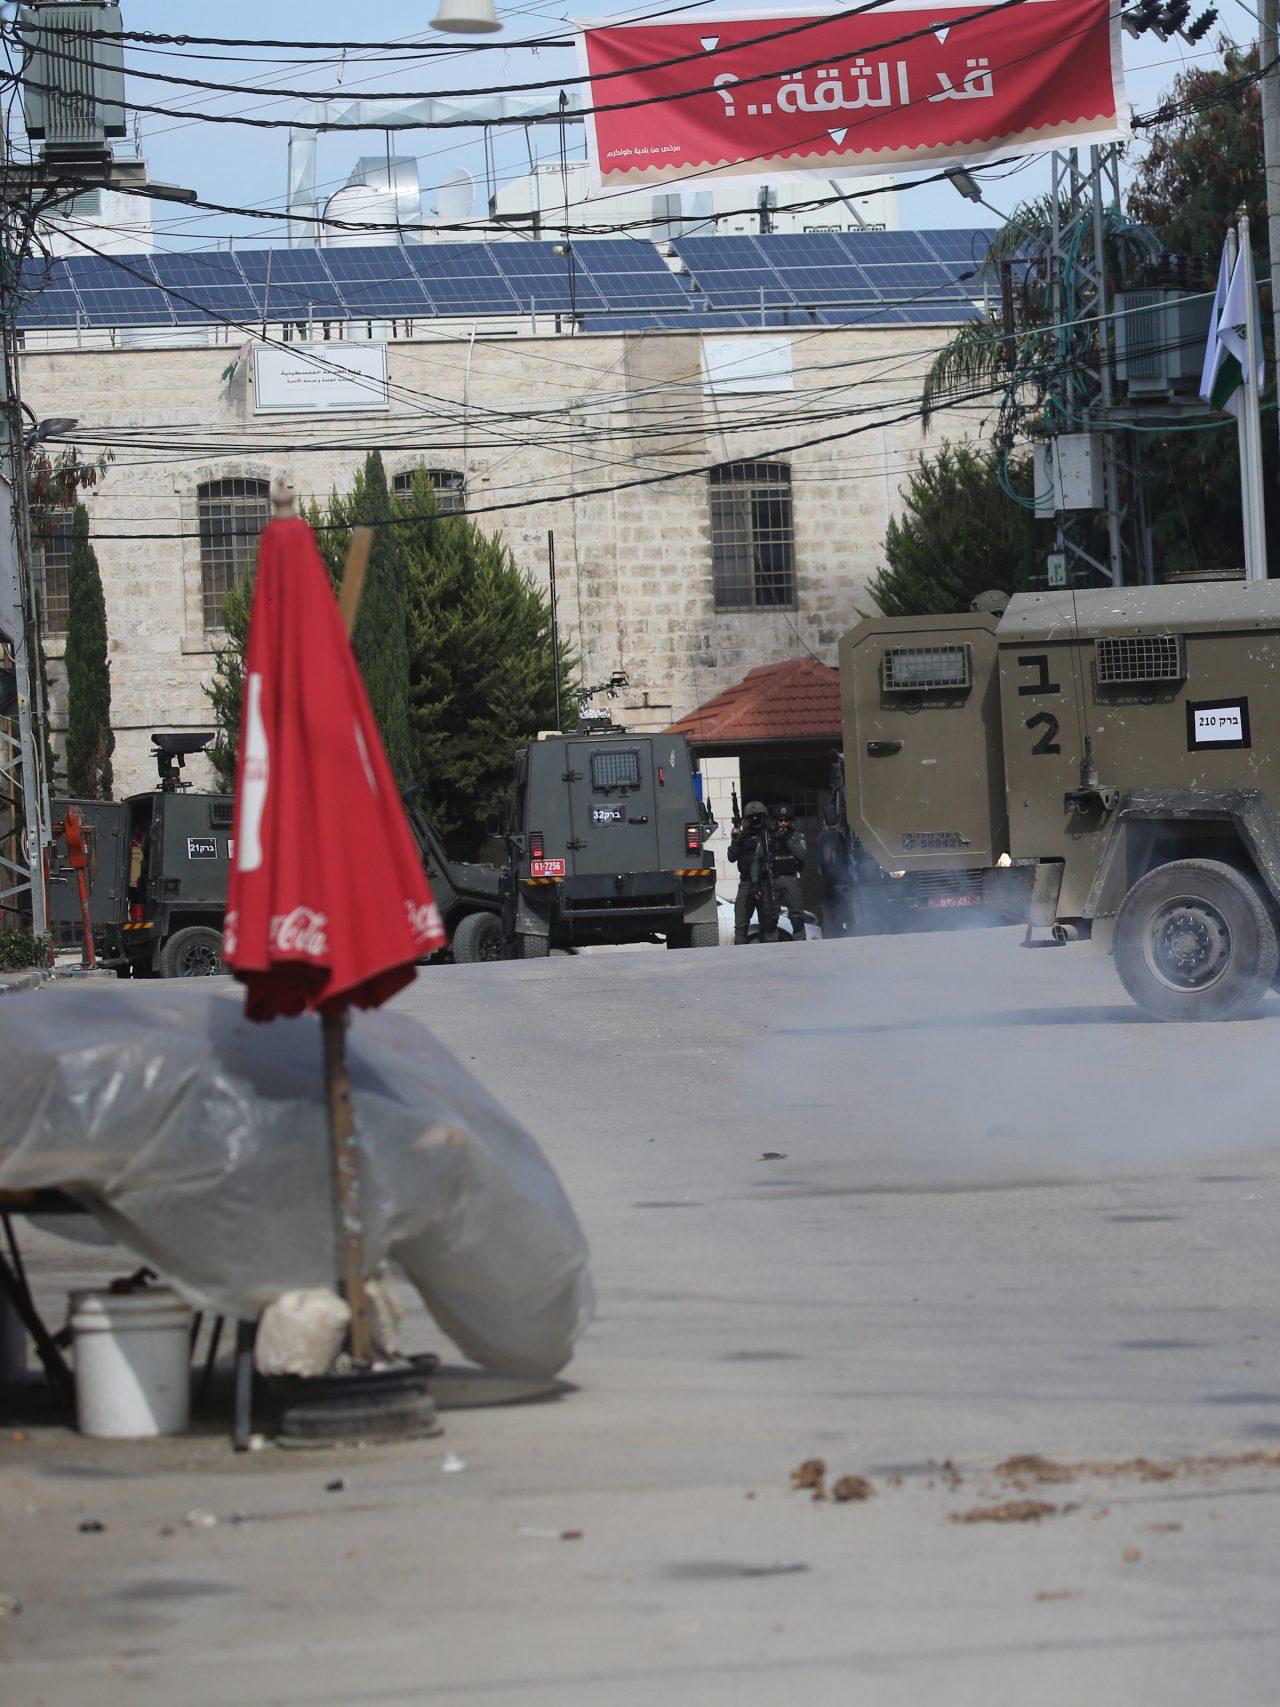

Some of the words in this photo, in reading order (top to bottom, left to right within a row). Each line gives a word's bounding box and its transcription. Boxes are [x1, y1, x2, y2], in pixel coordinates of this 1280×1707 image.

[927, 57, 994, 102] قد
[606, 148, 633, 158] طولكرم
[633, 146, 649, 155] بلدية
[650, 146, 660, 154] من
[661, 144, 681, 153] مرخص
[1199, 716, 1216, 727] 210
[1219, 716, 1239, 728] ברק
